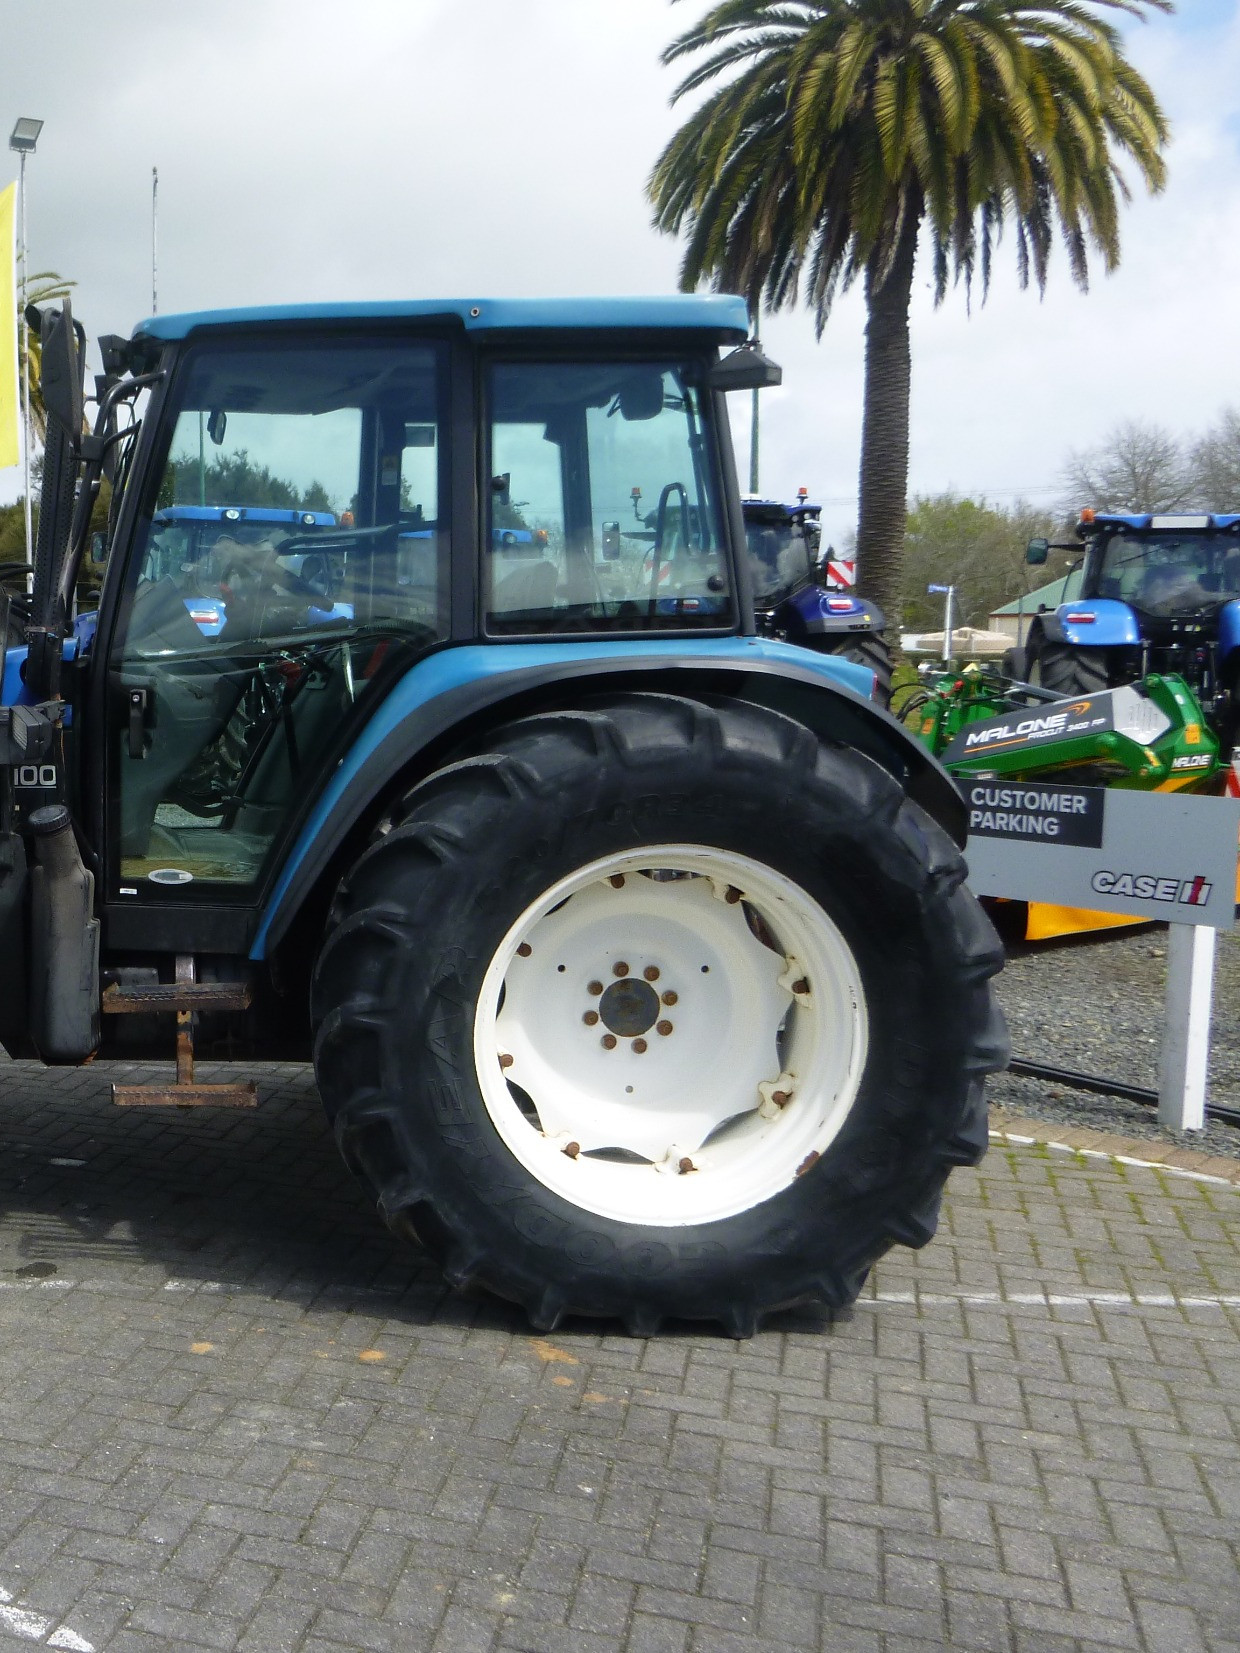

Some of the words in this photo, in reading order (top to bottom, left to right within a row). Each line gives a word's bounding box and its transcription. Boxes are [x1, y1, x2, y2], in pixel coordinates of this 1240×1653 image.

[966, 713, 1069, 746] MALONE
[970, 787, 1088, 815] CUSTOMER
[969, 810, 1060, 836] PARKING
[1091, 870, 1179, 902] CASE
